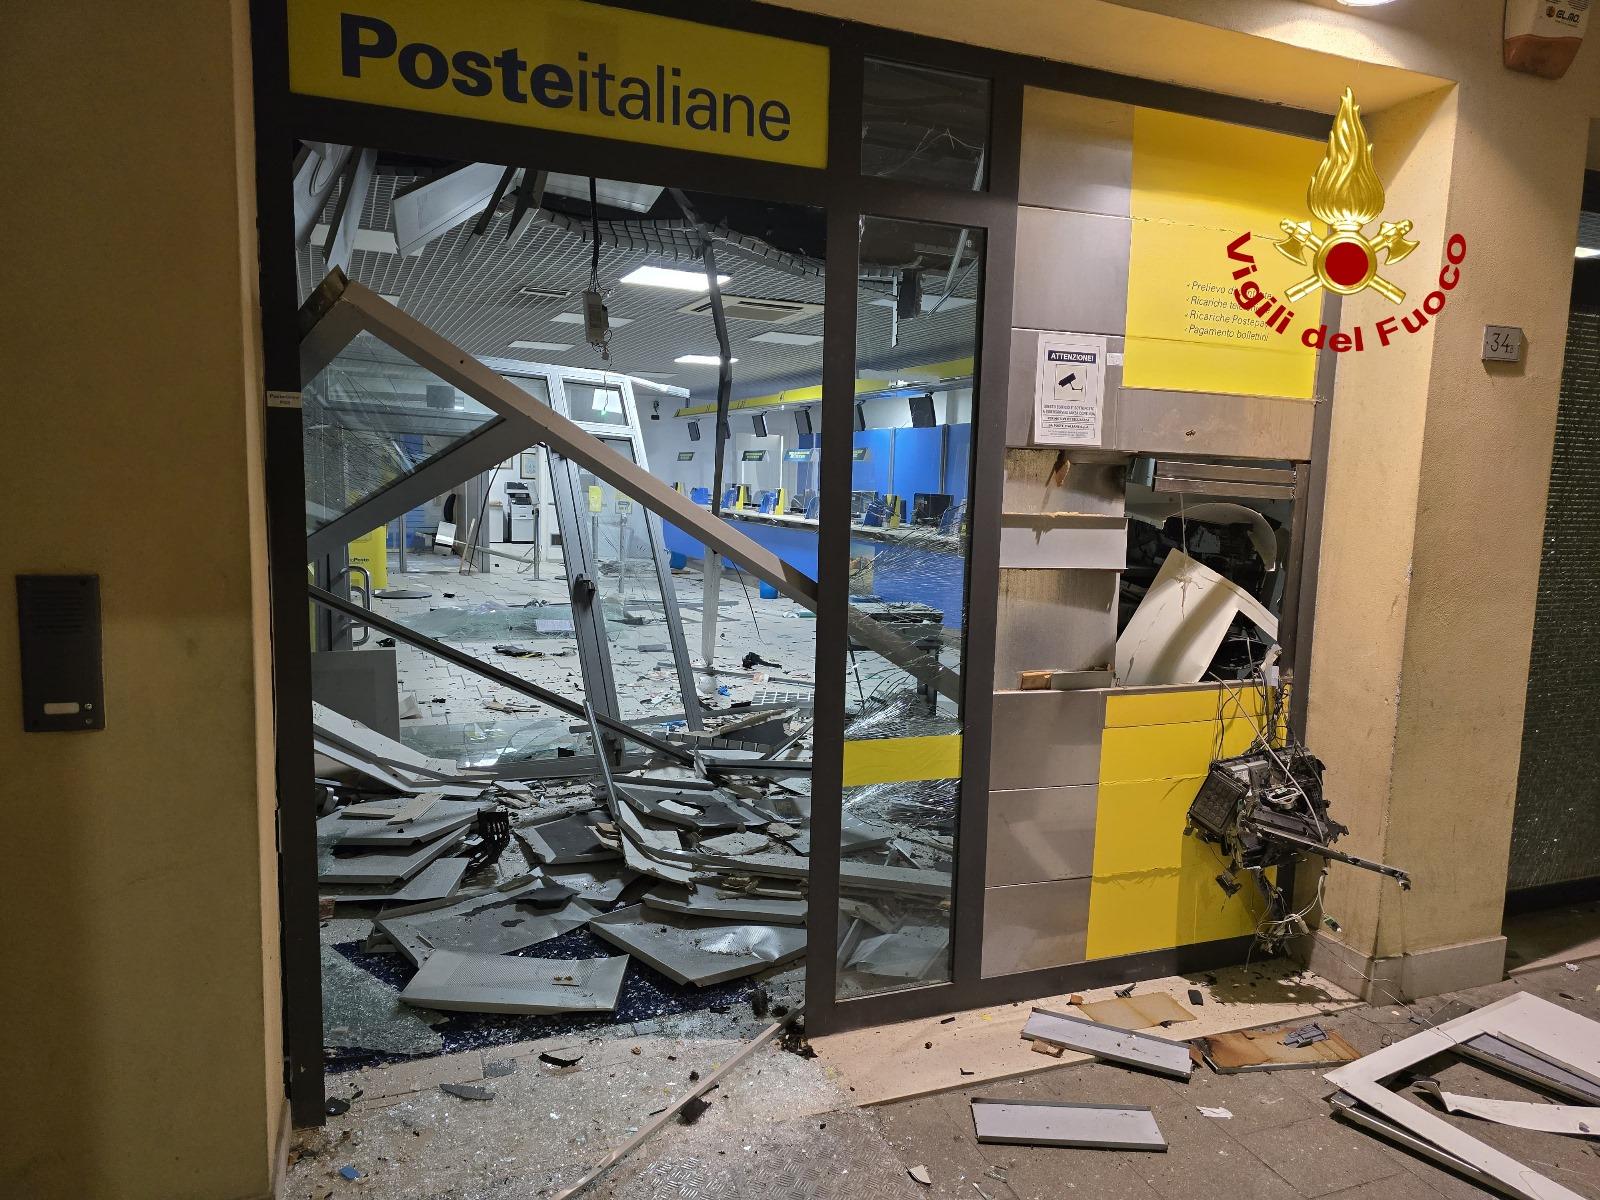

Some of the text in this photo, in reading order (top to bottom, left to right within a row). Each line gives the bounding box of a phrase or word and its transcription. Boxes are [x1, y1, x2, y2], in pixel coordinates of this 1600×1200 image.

[1191, 281, 1226, 294] Prelievo
[1190, 296, 1228, 309] Ricariche
[1189, 310, 1230, 323] Ricariche
[1188, 324, 1234, 338] Pagamento
[1050, 352, 1094, 362] ATTENZIONE!
